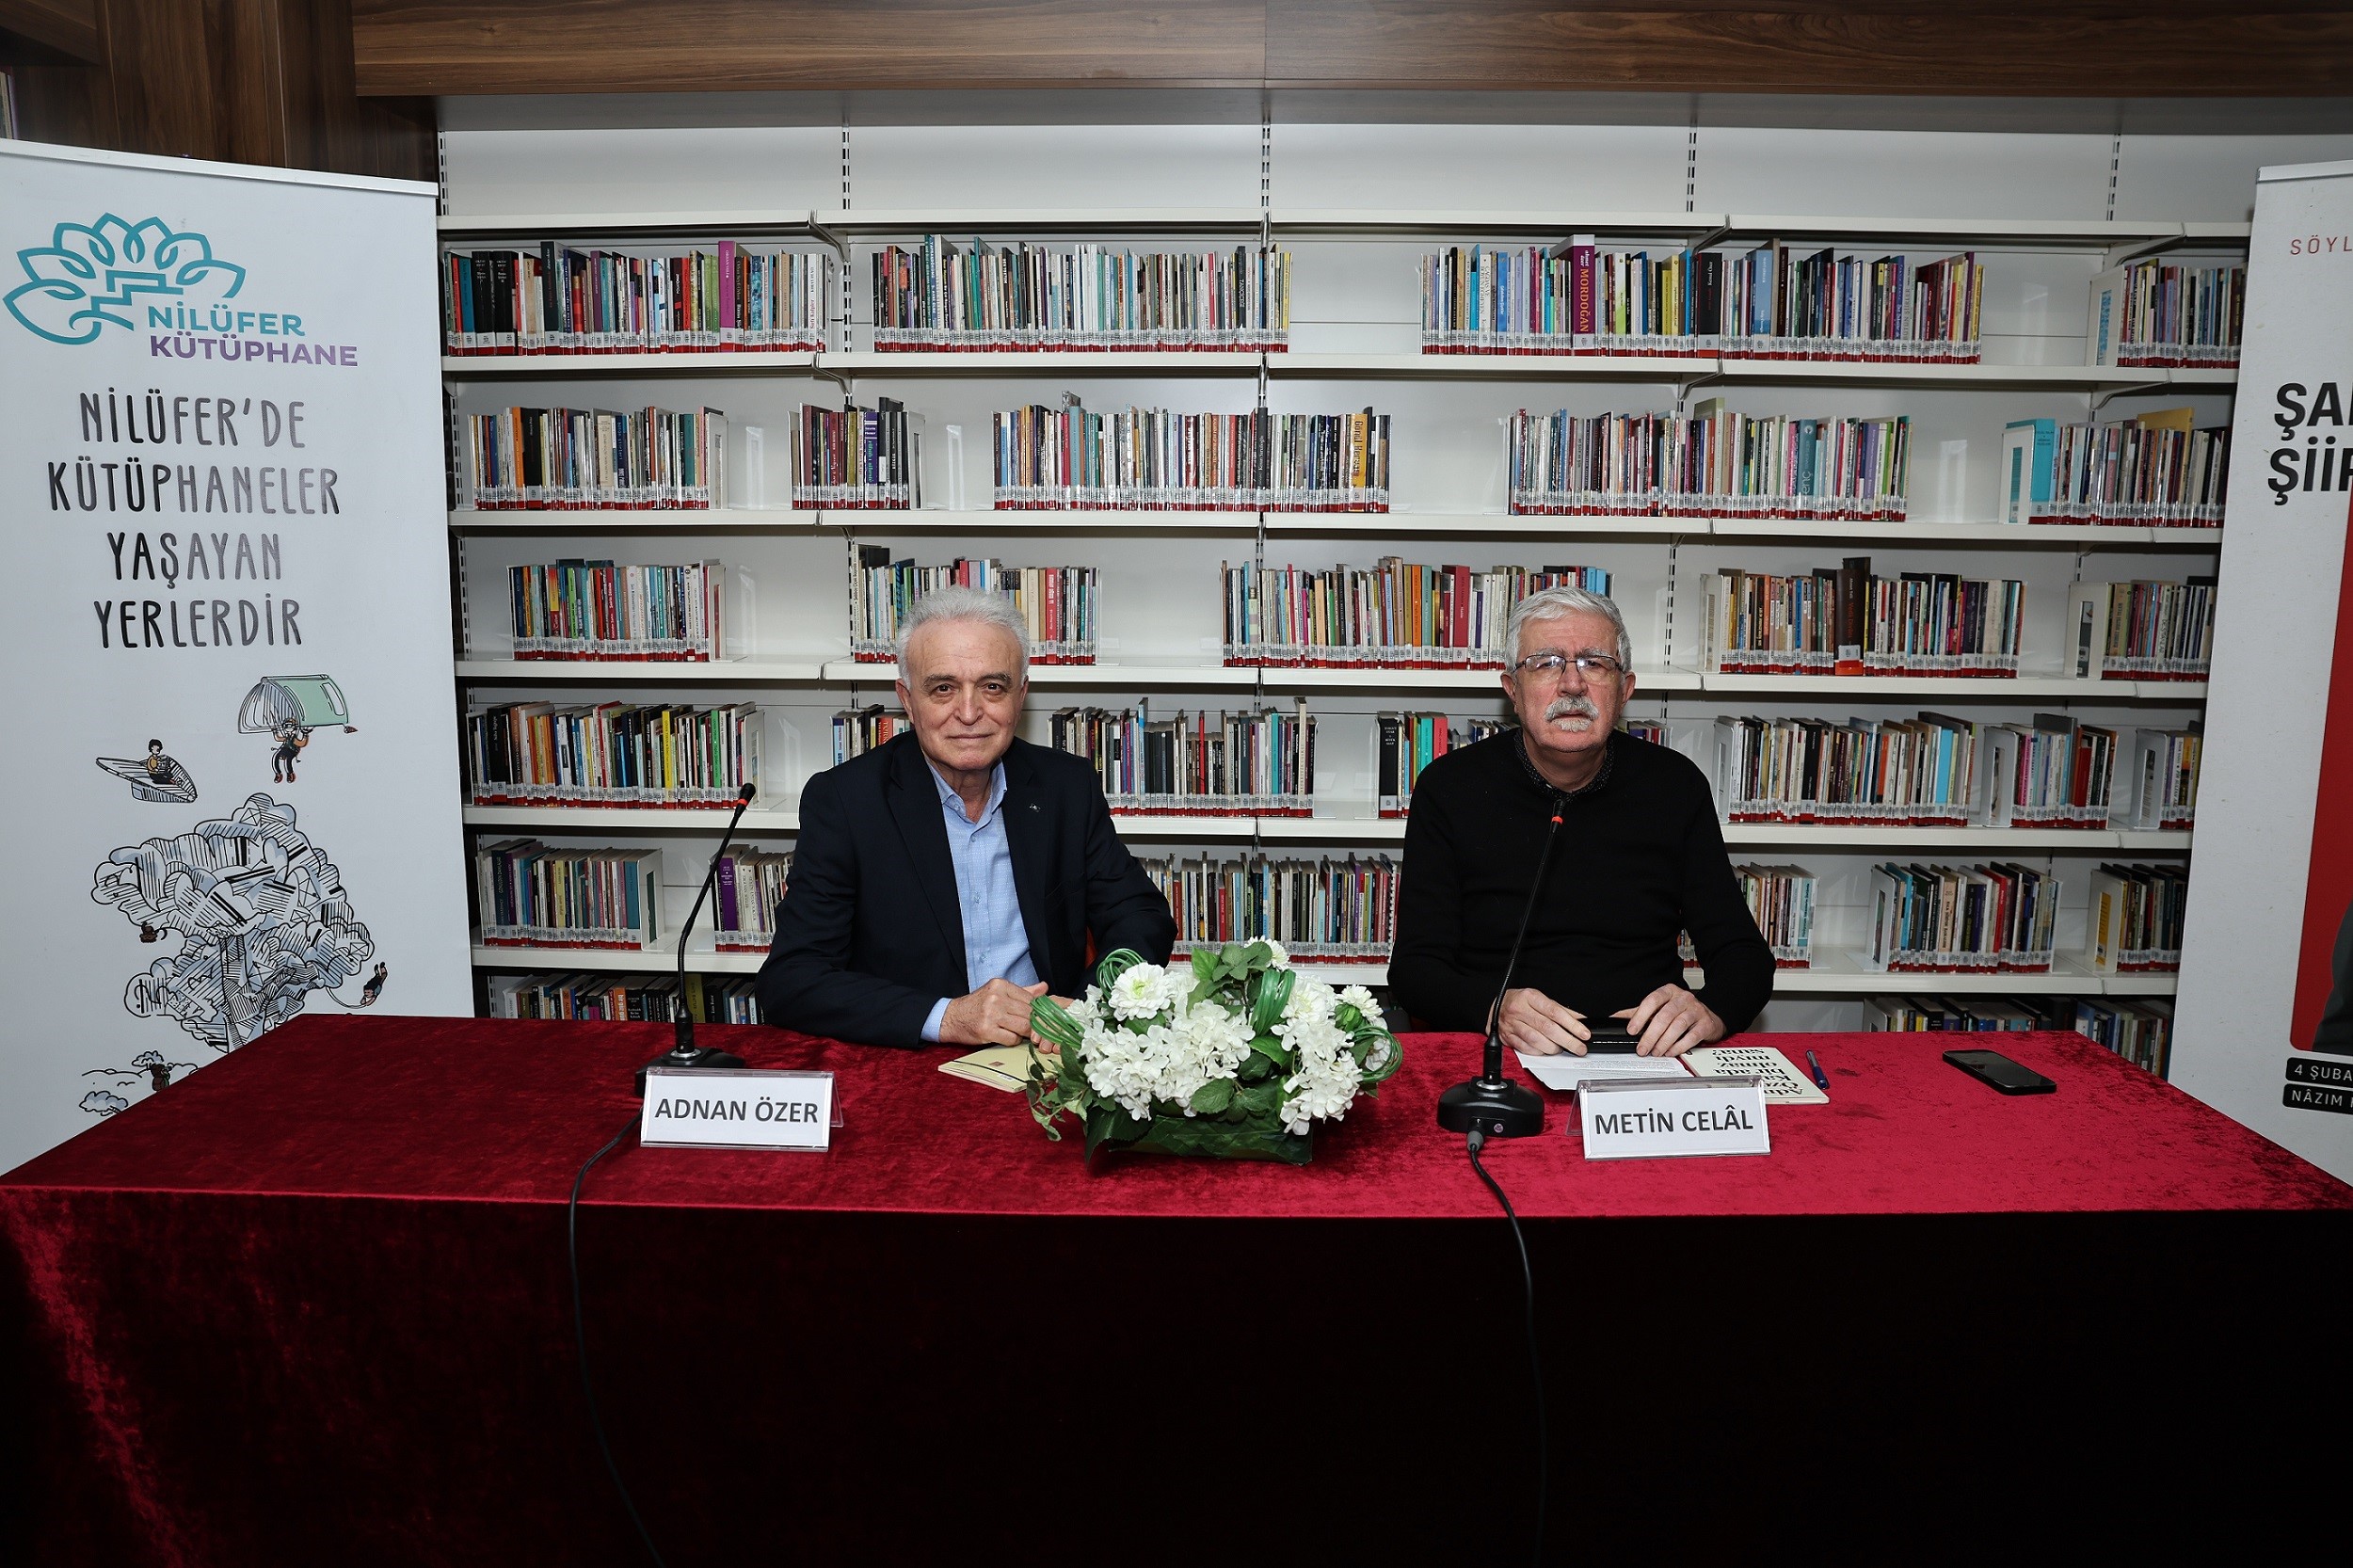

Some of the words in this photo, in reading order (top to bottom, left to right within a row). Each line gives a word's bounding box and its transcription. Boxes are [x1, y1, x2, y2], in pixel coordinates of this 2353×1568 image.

[1579, 267, 1592, 332] MORDOĞAN
[148, 301, 306, 337] NİLÜFER
[150, 331, 359, 367] KÜTÜPHANE
[79, 387, 306, 448] NİLÜFER'DE
[47, 456, 341, 515] KÜTÜPHANELER
[106, 532, 282, 590] YAŞAYAN
[93, 593, 303, 648] YERLERDİR
[2294, 1064, 2303, 1076] 4
[2310, 1065, 2353, 1081] ŞUBA
[654, 1098, 747, 1122] ADNAN
[754, 1096, 819, 1124] ÖZER
[2291, 1088, 2343, 1107] NÂZIM
[1594, 1107, 1674, 1135] METİN
[1681, 1104, 1753, 1132] CELÂL
